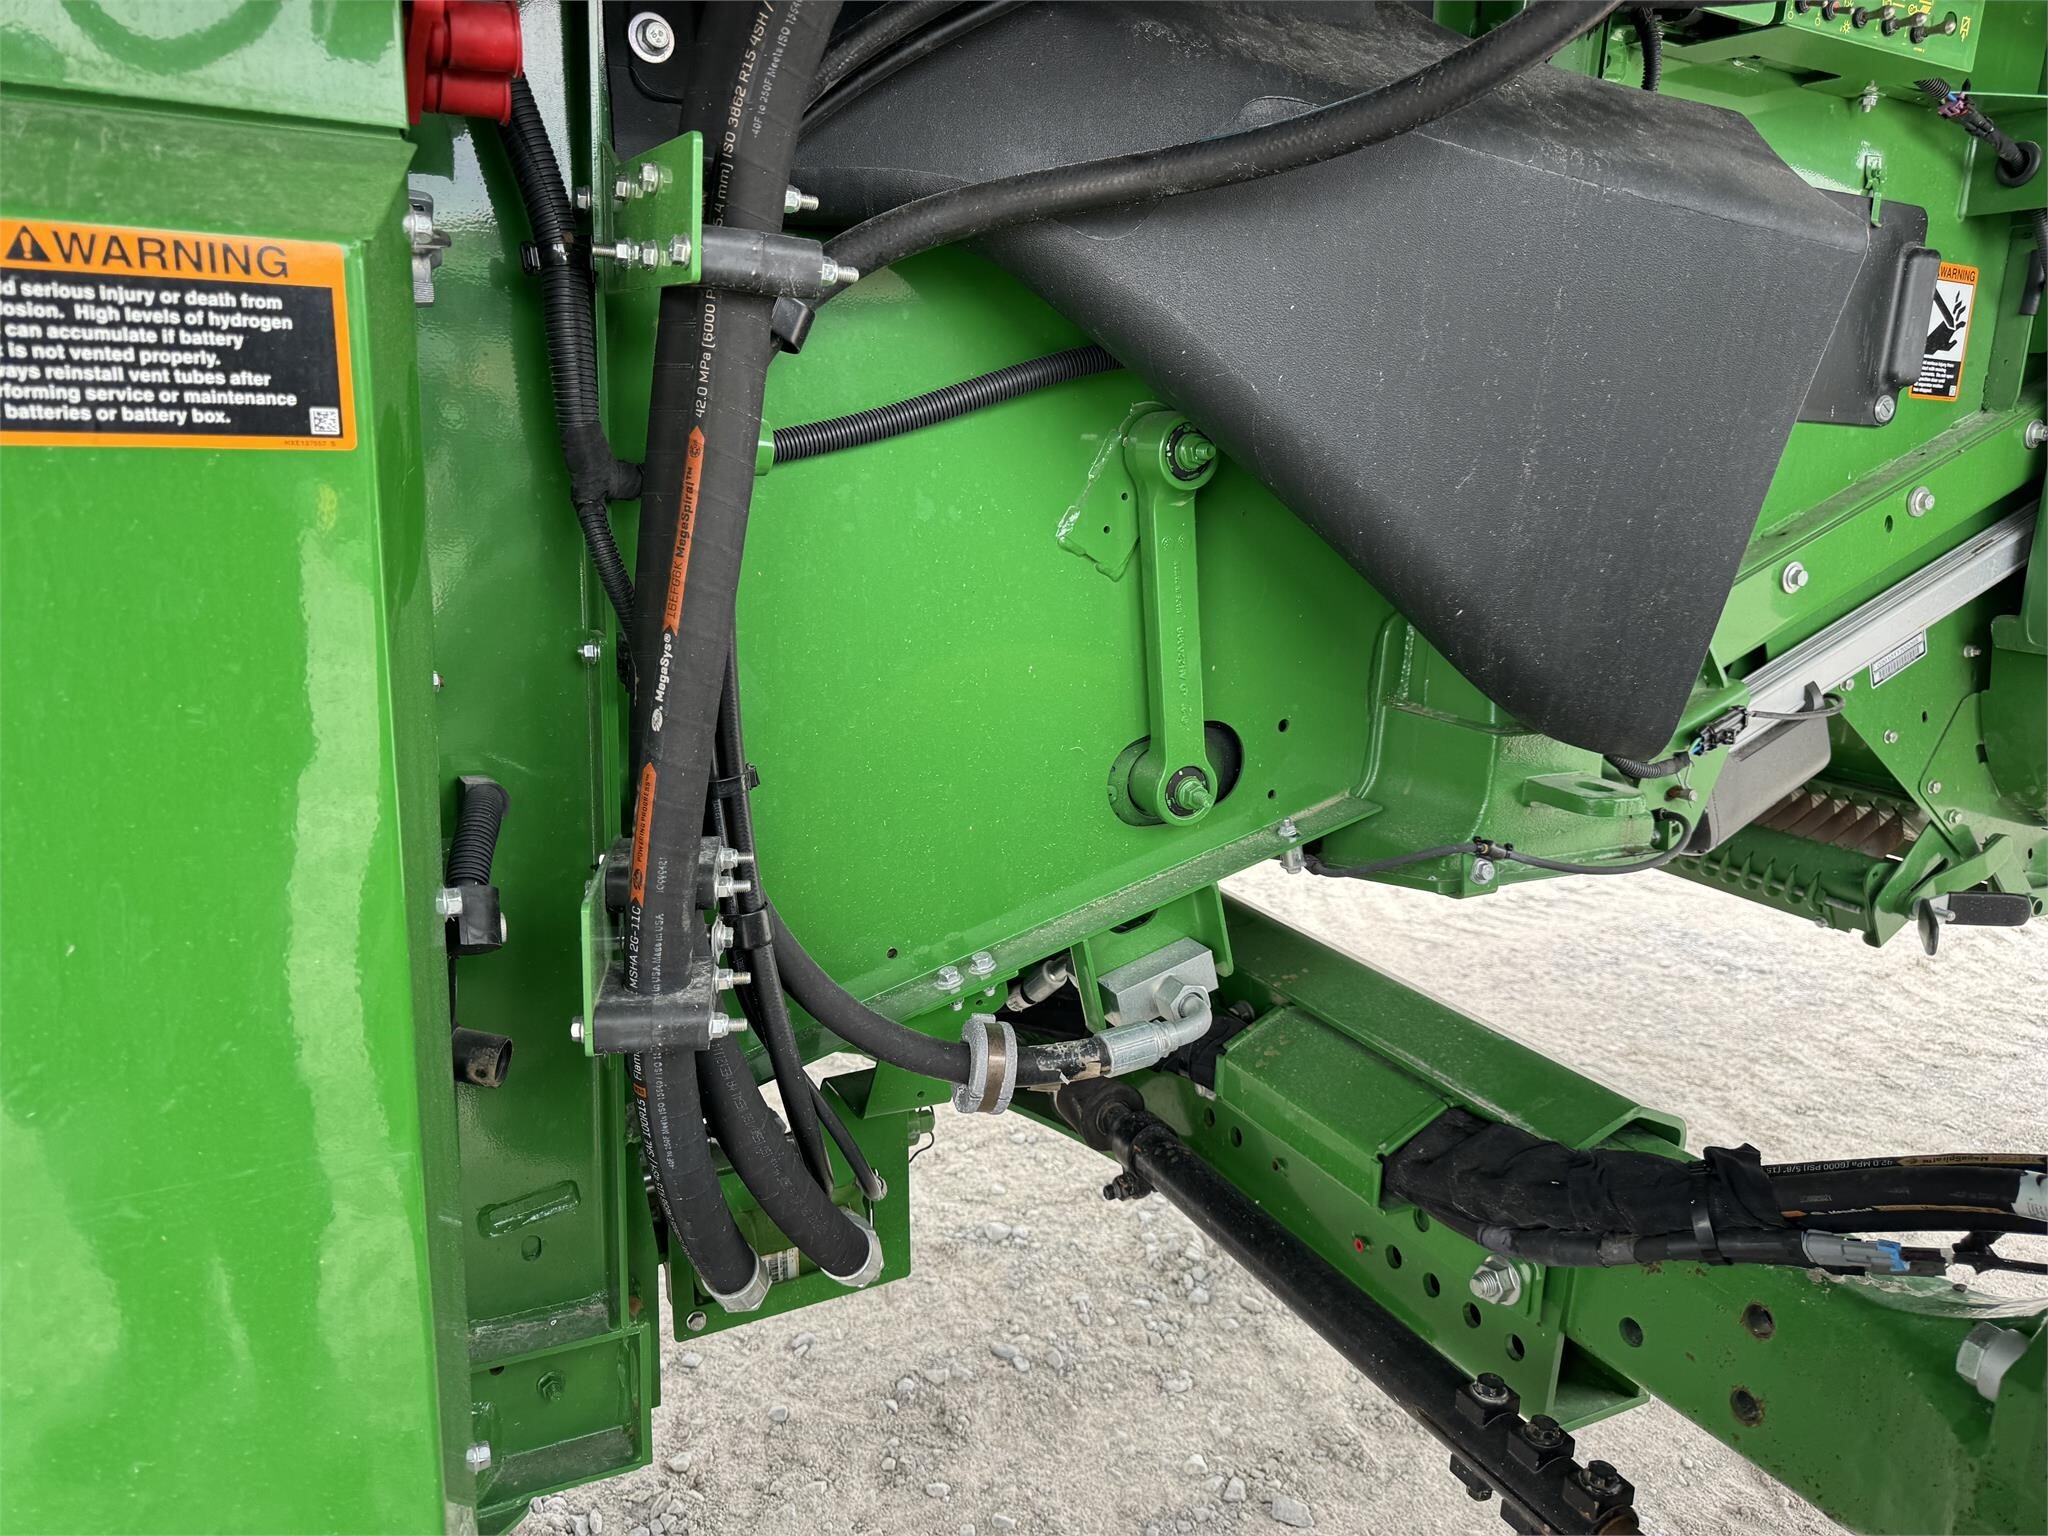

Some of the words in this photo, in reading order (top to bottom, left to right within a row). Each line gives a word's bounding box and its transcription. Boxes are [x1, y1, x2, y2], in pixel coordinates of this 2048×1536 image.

[748, 11, 769, 46] 4SH
[738, 48, 757, 83] R15
[761, 77, 773, 103] 250F
[767, 48, 784, 78] Meets
[778, 26, 791, 47] ISO
[727, 84, 747, 128] 3862
[722, 131, 736, 159] ISO
[52, 231, 289, 278] WARNING
[1940, 266, 1976, 282] WARNING
[20, 281, 97, 302] serious
[98, 284, 156, 308] injury
[159, 291, 182, 306] or
[184, 289, 237, 308] death
[240, 292, 284, 311] from
[74, 303, 121, 325] High
[124, 306, 182, 325] levels
[184, 309, 205, 326] of
[208, 311, 294, 332] hydrogen
[4, 323, 43, 339] can
[46, 325, 158, 343] accumulate
[161, 328, 176, 345] if
[179, 329, 245, 351] battery
[7, 341, 28, 359] is
[31, 344, 66, 360] not
[68, 346, 136, 363] vented
[139, 349, 222, 369] properly.
[699, 352, 712, 383] MPa
[44, 364, 125, 382] reinstall
[128, 369, 171, 384] vent
[173, 370, 226, 386] tubes
[229, 370, 272, 387] after
[85, 385, 155, 403] service
[158, 389, 180, 404] or
[183, 389, 298, 407] maintenance
[695, 385, 708, 418] 42.0
[4, 403, 92, 421] batteries
[95, 408, 118, 422] or
[121, 406, 188, 426] battery
[191, 407, 232, 424] box.
[636, 823, 646, 863] POWERING
[629, 905, 641, 952] 2G-11C
[655, 913, 664, 932] USA
[652, 943, 663, 964] Made
[629, 954, 640, 989] MSHA
[652, 965, 661, 983] USA
[637, 1098, 651, 1138] 100R15
[658, 1102, 667, 1115] ISO
